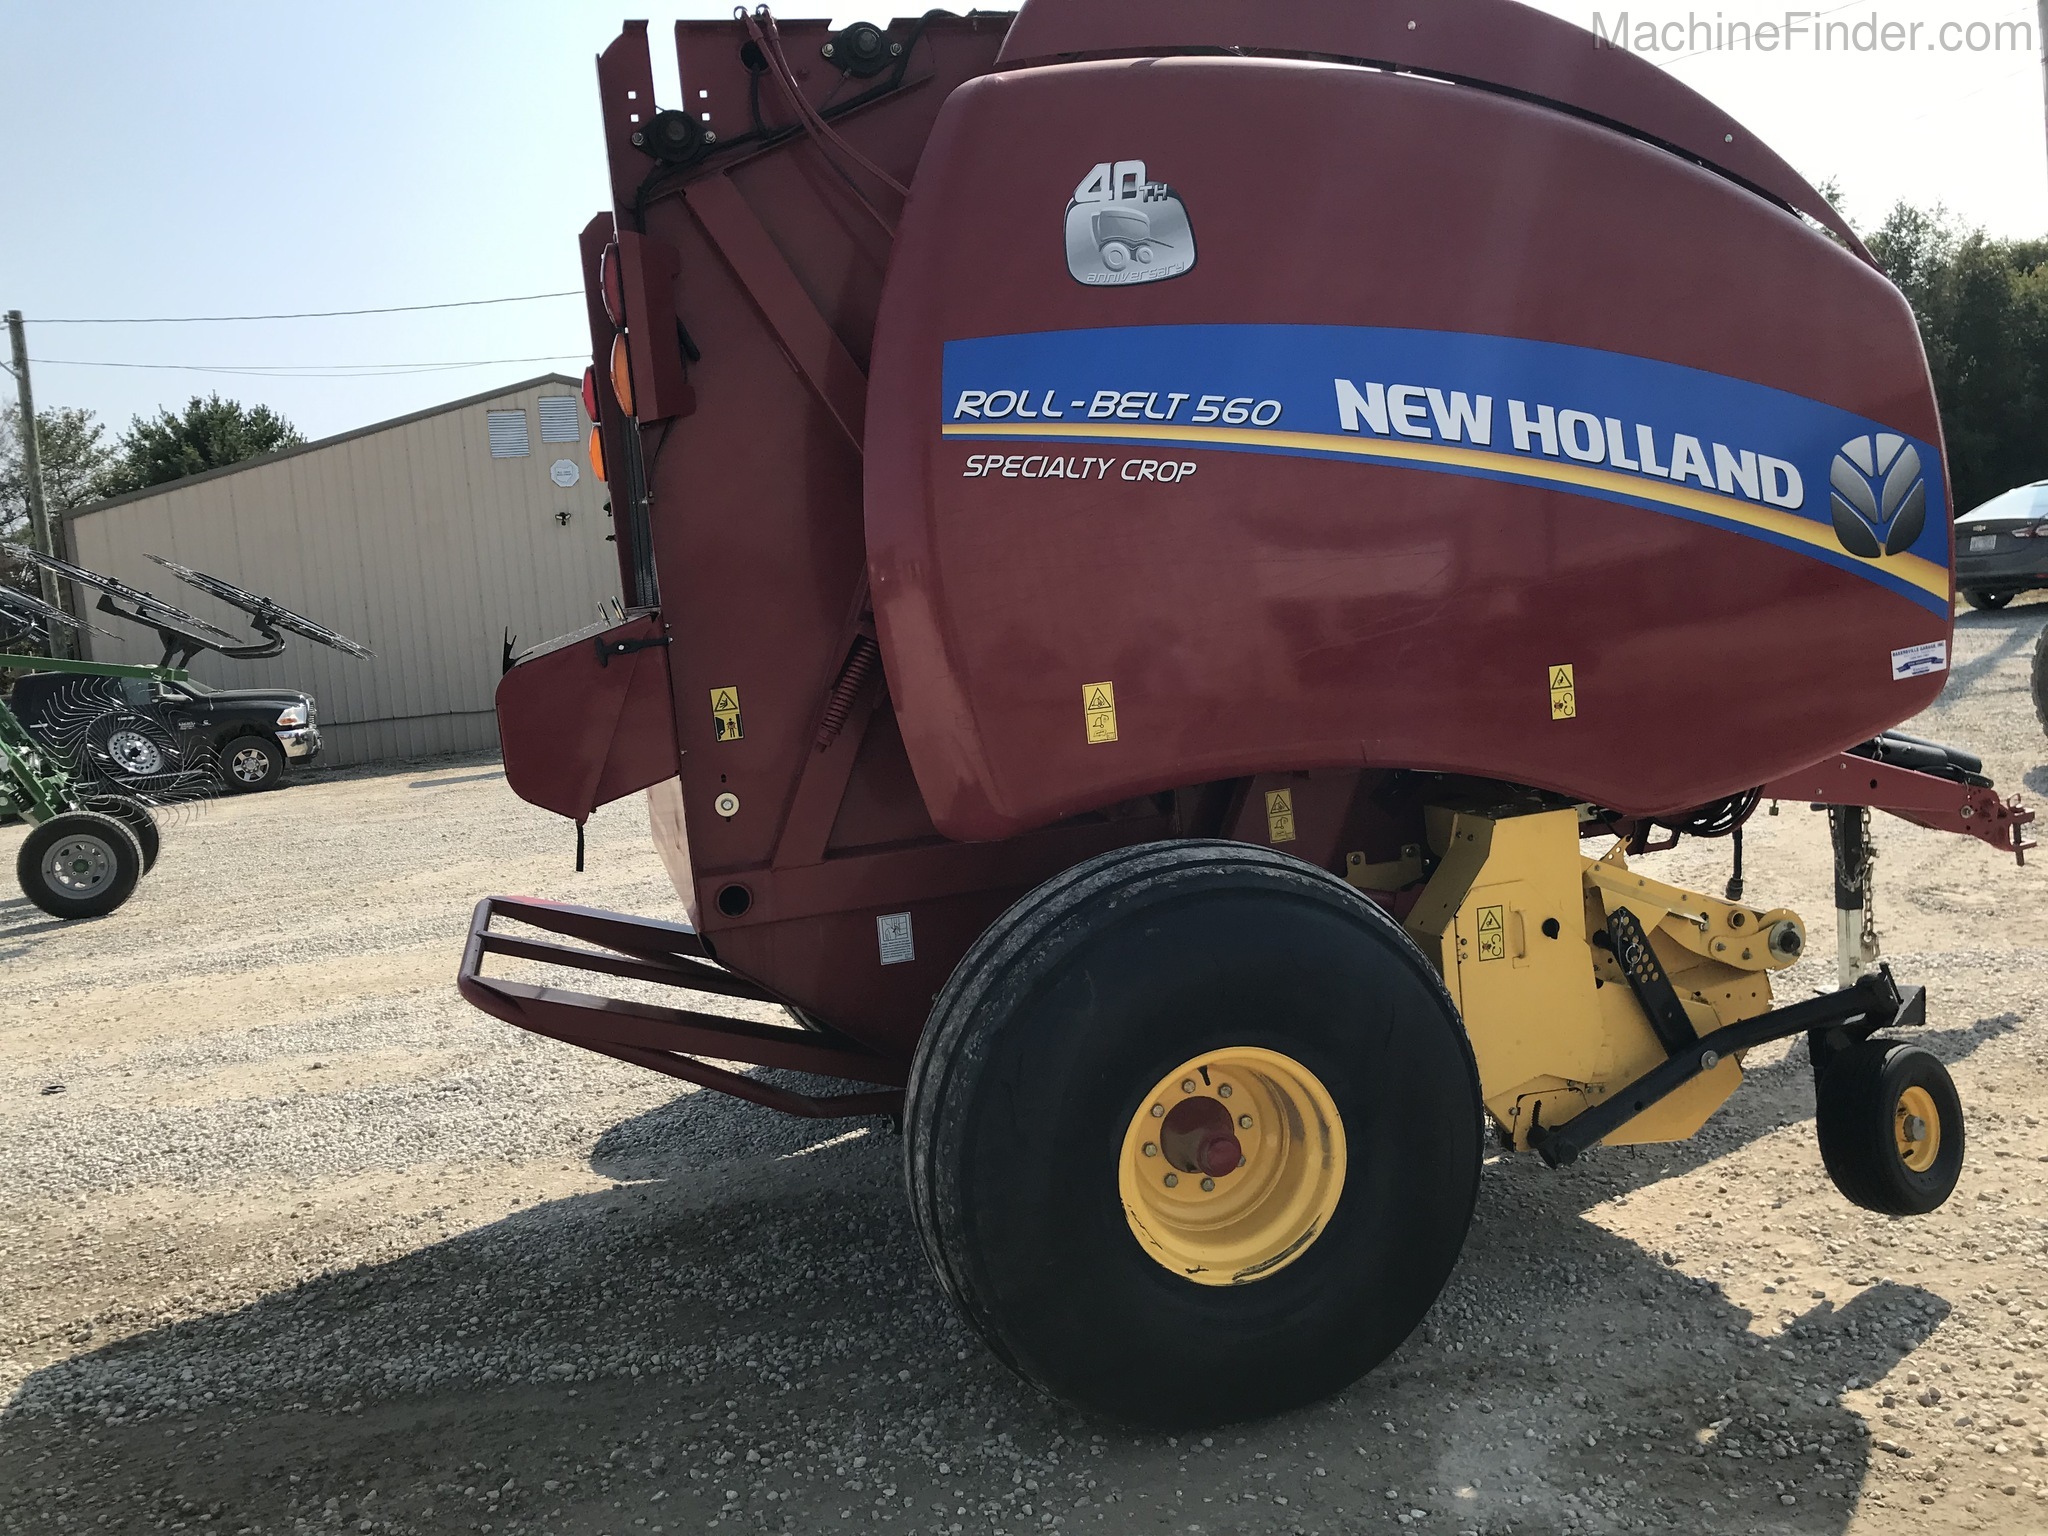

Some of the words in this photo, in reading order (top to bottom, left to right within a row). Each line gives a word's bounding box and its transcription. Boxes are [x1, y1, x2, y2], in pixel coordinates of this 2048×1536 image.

[1086, 262, 1185, 282] anniversary
[1191, 395, 1282, 426] 560
[1334, 378, 1492, 445] NEW
[1508, 399, 1804, 509] HOLLAND
[962, 454, 1116, 480] SPECIALTY
[1120, 459, 1197, 483] CROP
